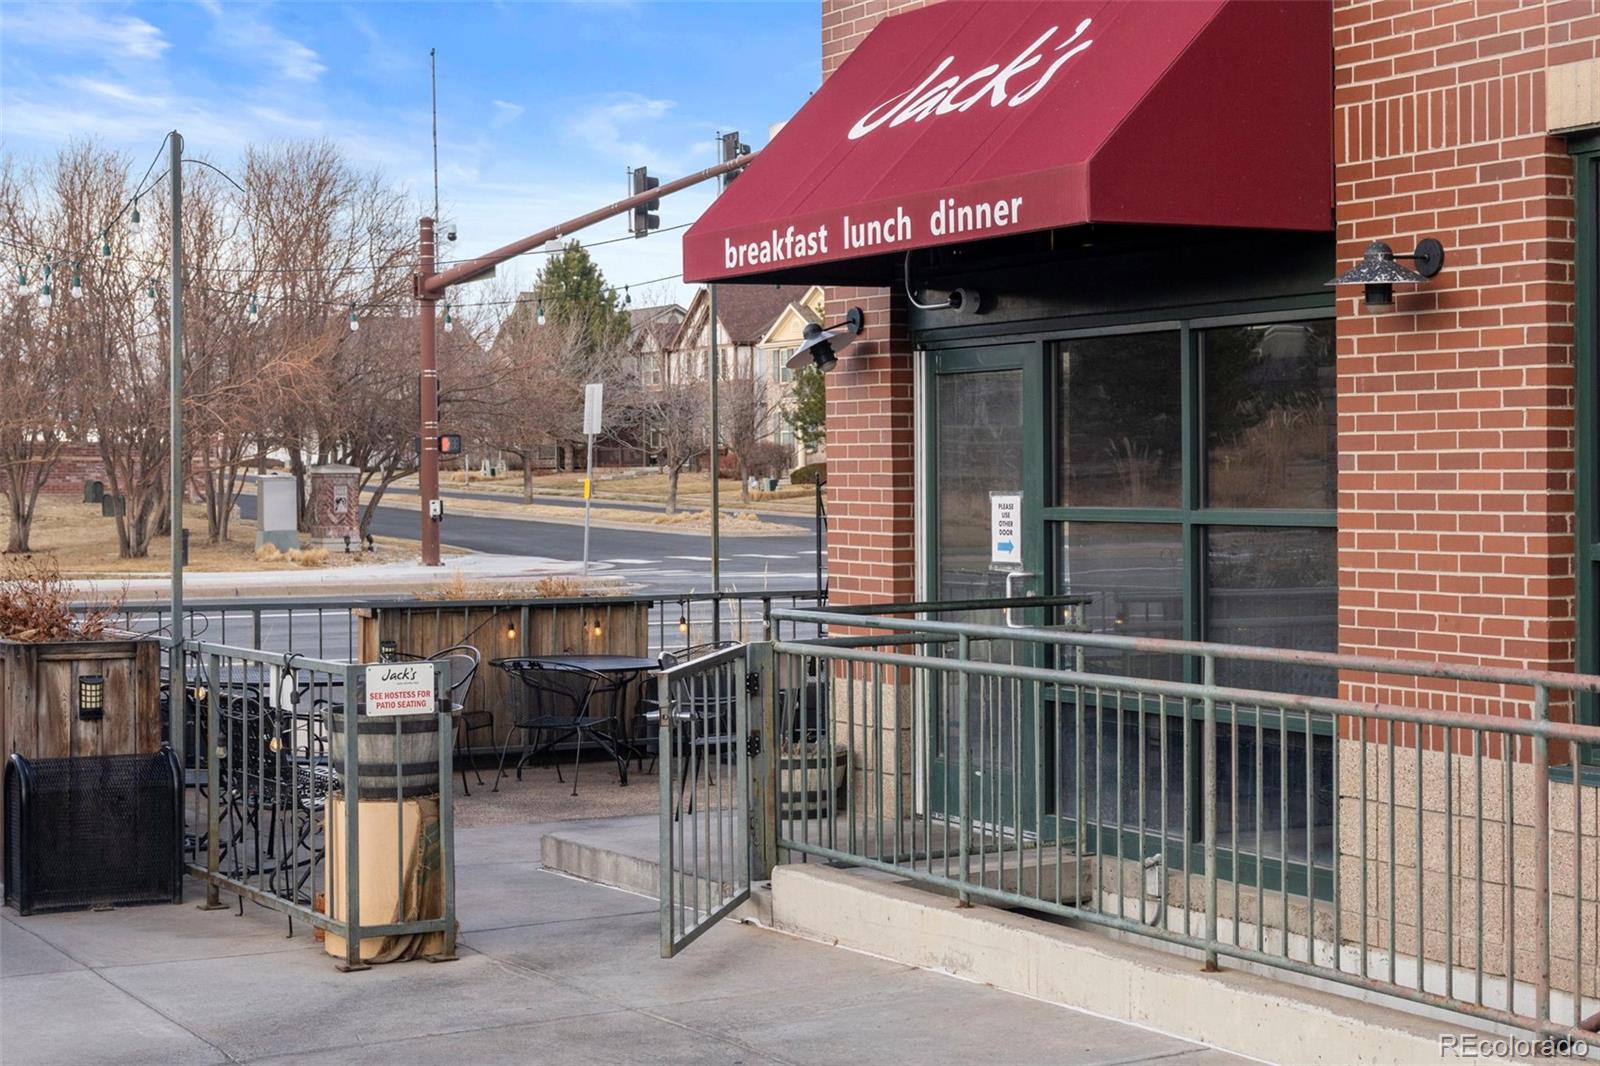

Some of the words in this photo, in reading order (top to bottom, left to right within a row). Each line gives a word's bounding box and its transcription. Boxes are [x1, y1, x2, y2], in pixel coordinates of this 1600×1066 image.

[848, 17, 1093, 141] Jack's
[725, 224, 829, 269] breakfast
[843, 206, 912, 250] lunch
[930, 196, 1023, 236] dinner
[381, 667, 417, 682] Jack's
[370, 692, 384, 700] SEE
[384, 690, 416, 700] HOSTESS
[417, 690, 431, 698] FOR
[376, 702, 396, 710] PATIO
[398, 700, 426, 708] SEATING
